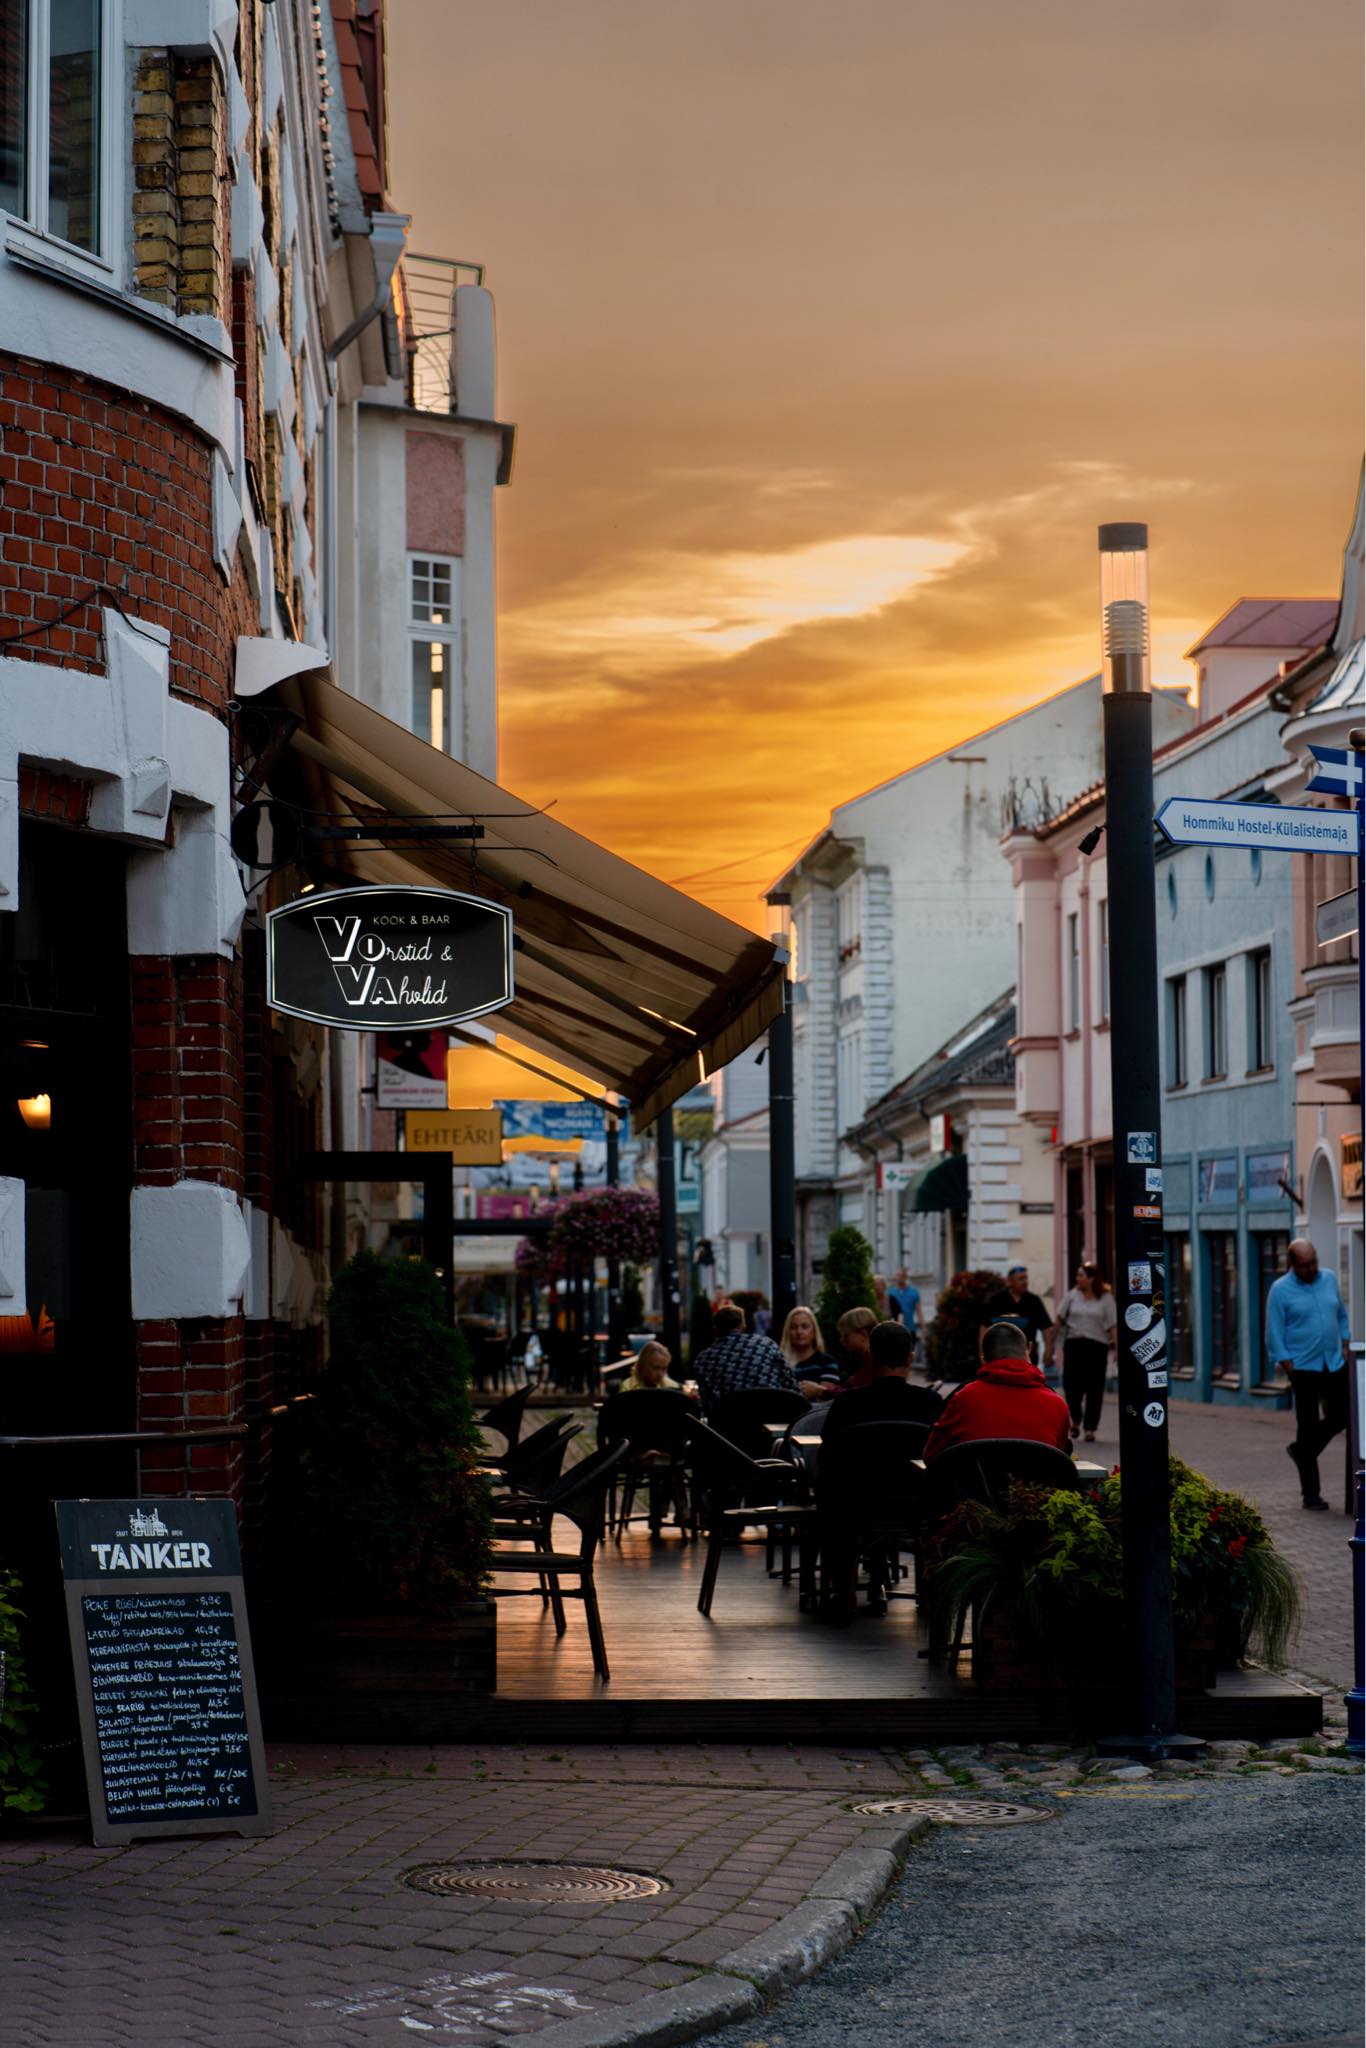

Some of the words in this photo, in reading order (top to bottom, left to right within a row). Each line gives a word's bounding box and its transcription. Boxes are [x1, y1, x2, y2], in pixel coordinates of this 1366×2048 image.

[1183, 813, 1235, 832] Hommiku
[1238, 817, 1348, 843] Hostel-Külalistemaja
[373, 915, 406, 926] KOOK
[410, 915, 418, 925] &
[421, 914, 451, 925] BAAR
[441, 945, 454, 961] &
[413, 1124, 494, 1146] EHTEÄRI
[91, 1541, 213, 1571] TANKER
